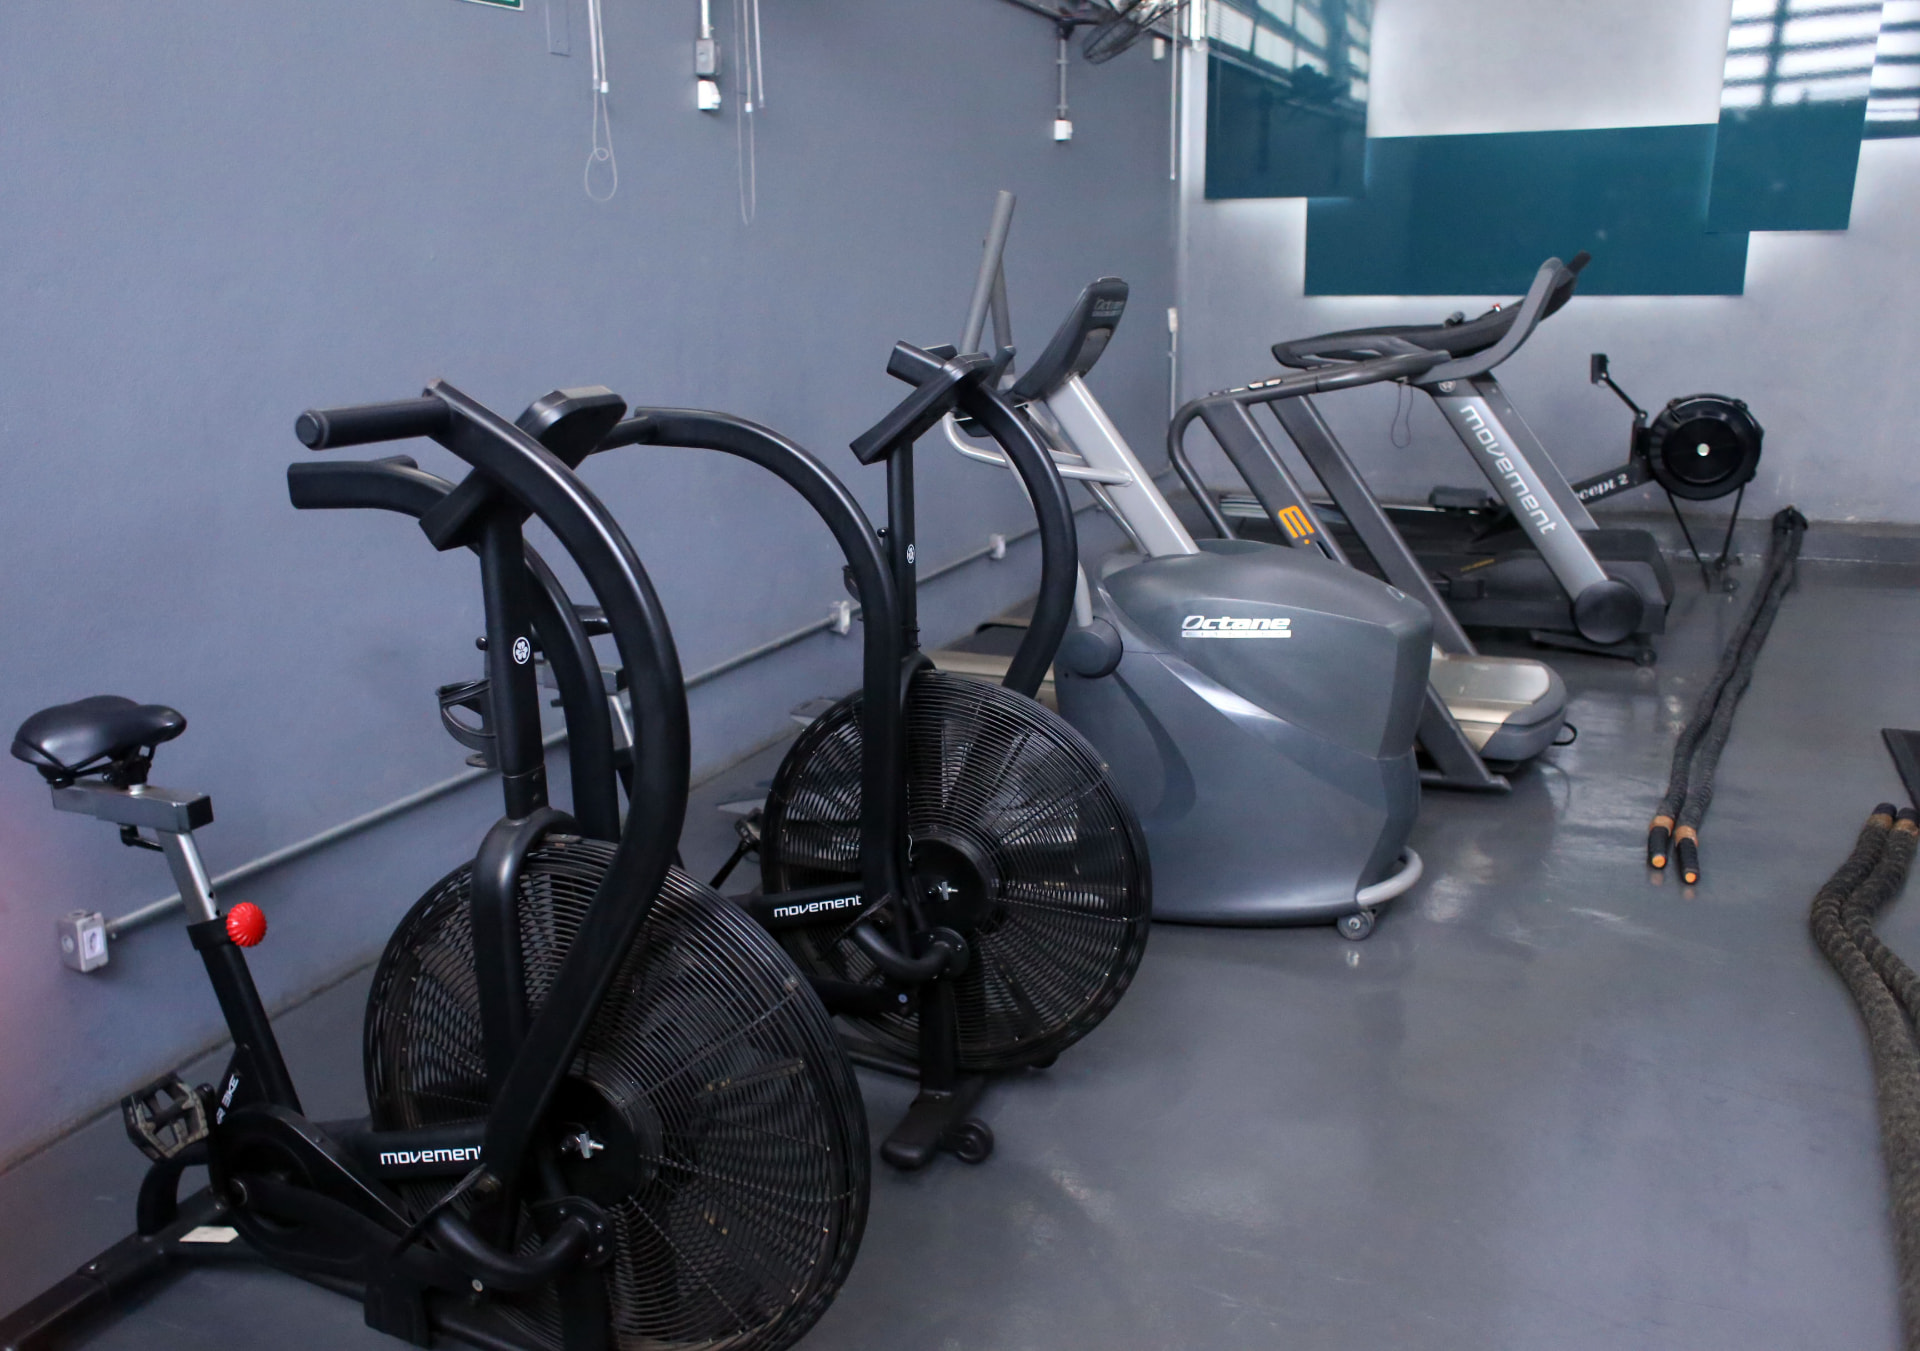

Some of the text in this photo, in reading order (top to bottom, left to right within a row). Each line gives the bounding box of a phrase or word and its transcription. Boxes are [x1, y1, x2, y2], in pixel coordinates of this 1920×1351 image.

[1460, 404, 1557, 535] movement
[1617, 473, 1629, 485] 2
[1181, 615, 1291, 630] Octane
[773, 894, 862, 918] movement
